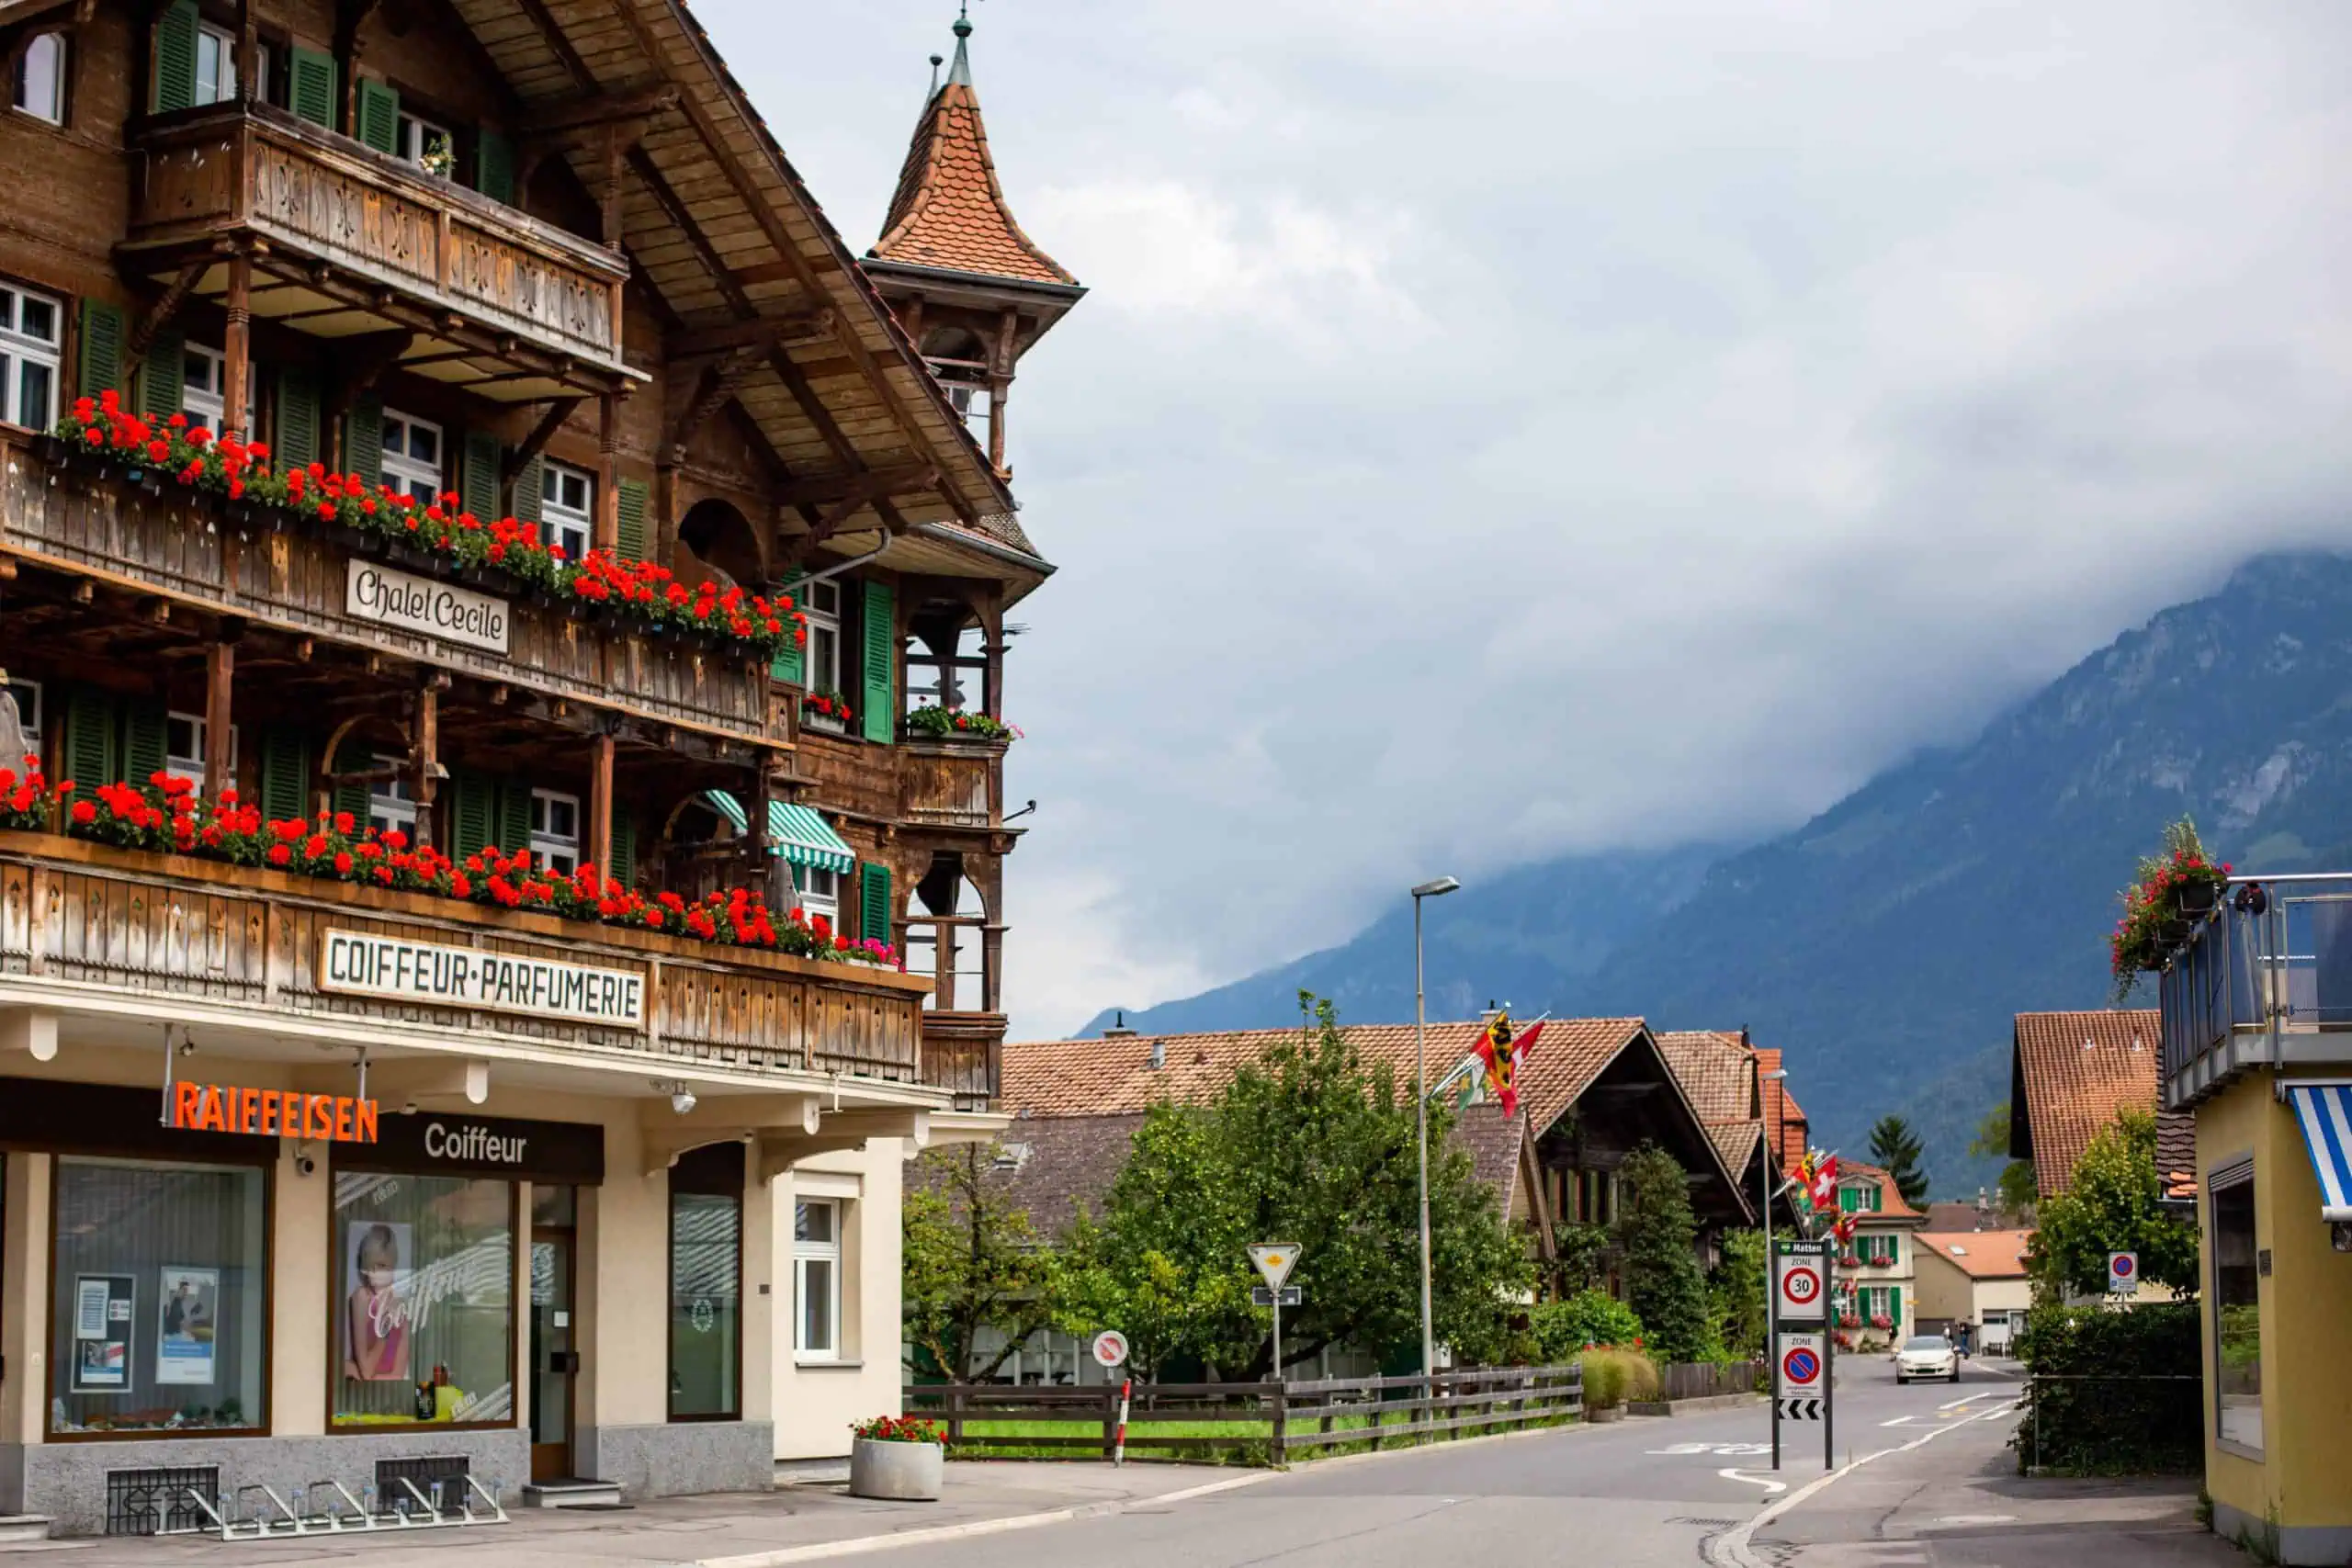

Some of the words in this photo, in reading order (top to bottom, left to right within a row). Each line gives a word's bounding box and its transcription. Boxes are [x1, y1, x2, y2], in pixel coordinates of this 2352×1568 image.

[356, 570, 430, 622] Chalet
[435, 592, 503, 640] Cecile
[175, 1080, 379, 1144] RAIFFEISEN
[425, 1122, 526, 1163] Coiffeur
[1791, 1257, 1812, 1266] ZONE
[1794, 1279, 1810, 1292] 30
